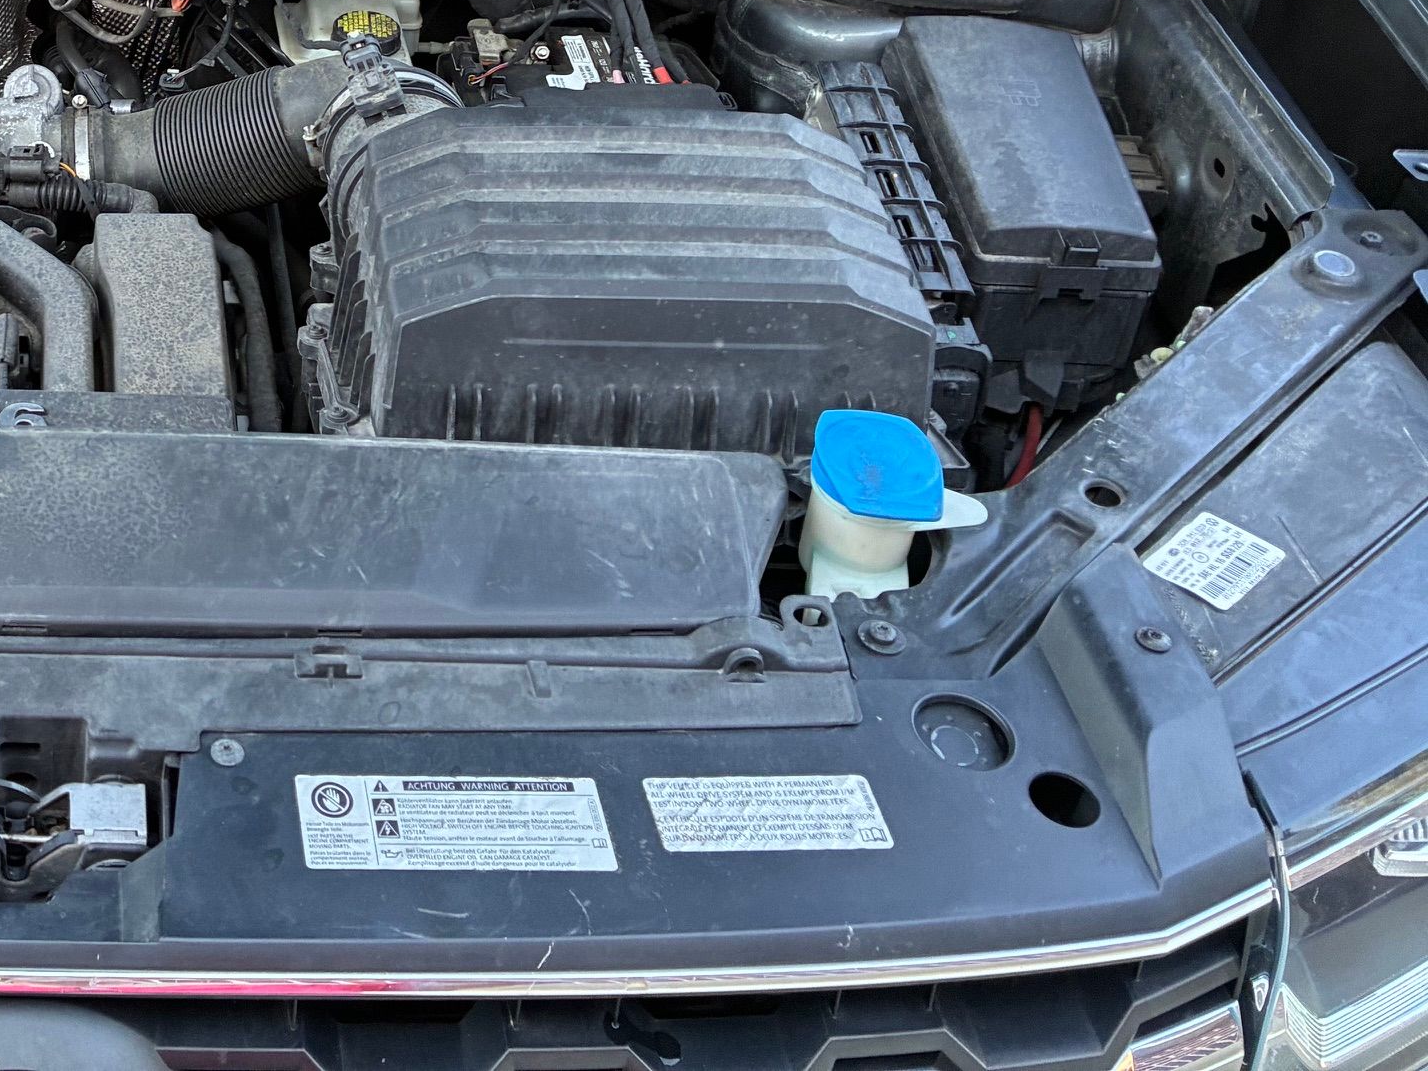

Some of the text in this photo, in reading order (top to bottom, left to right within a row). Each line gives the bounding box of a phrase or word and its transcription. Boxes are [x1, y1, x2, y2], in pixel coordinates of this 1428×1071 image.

[406, 781, 568, 791] ACHTUNG WARNING ATTENTION
[782, 779, 834, 787] PERMANENT
